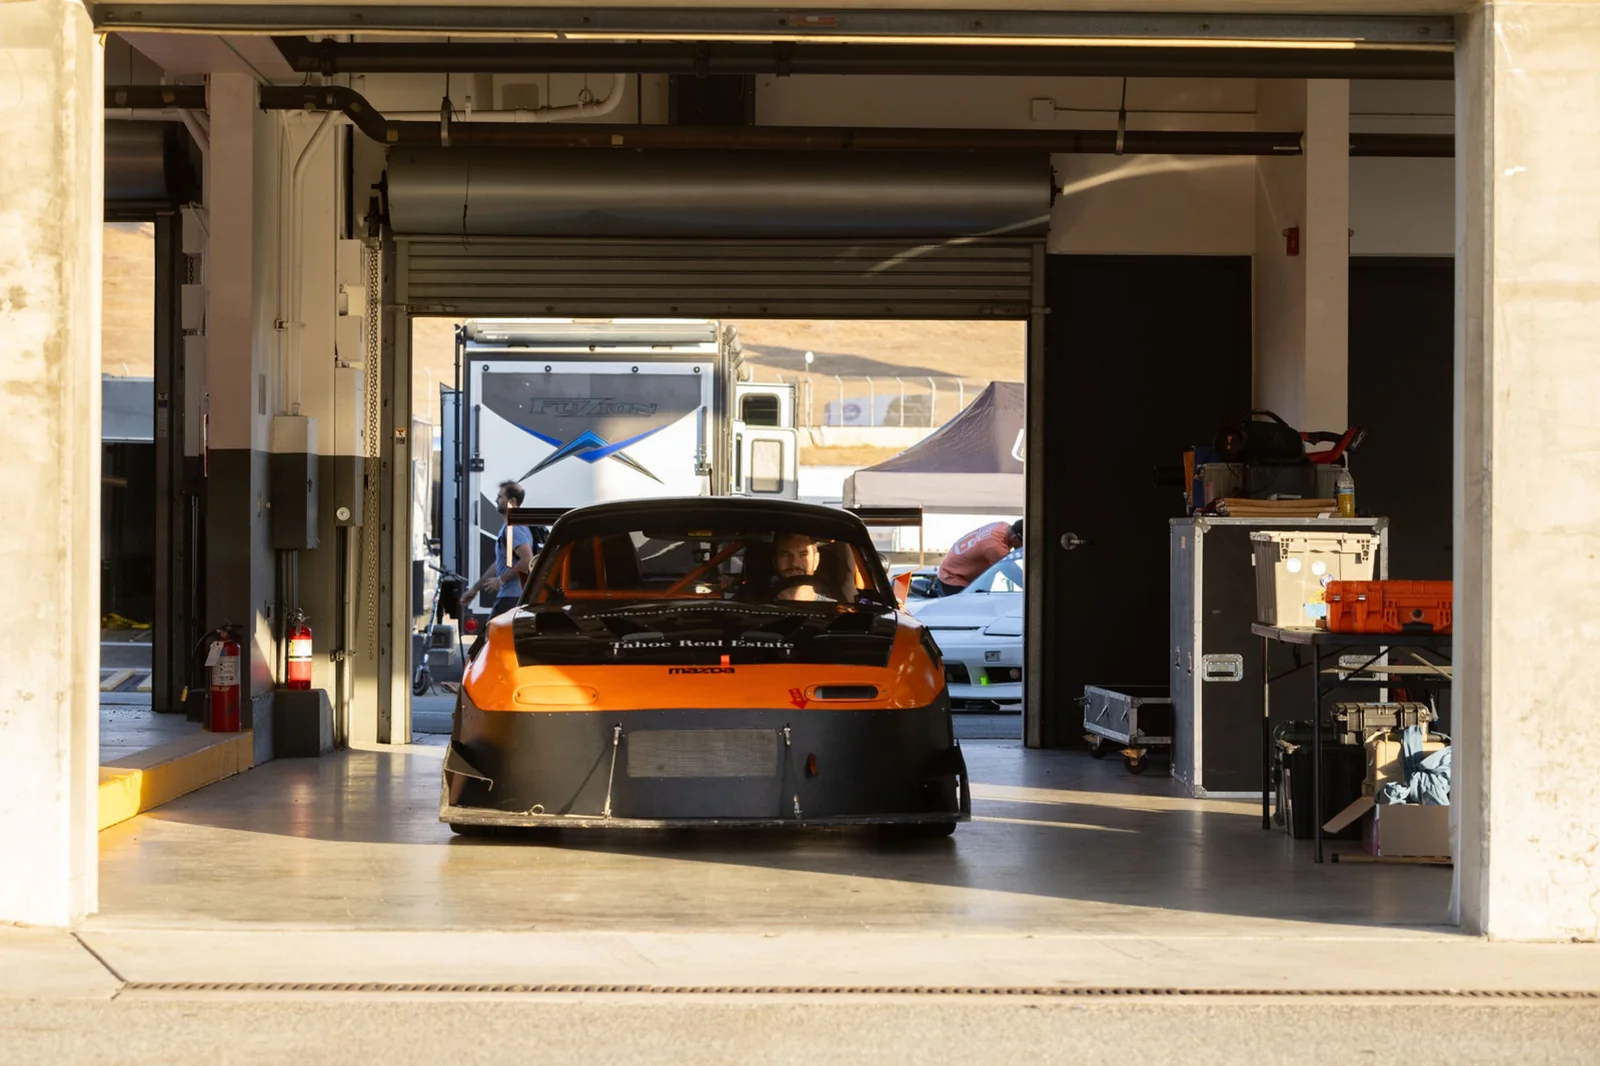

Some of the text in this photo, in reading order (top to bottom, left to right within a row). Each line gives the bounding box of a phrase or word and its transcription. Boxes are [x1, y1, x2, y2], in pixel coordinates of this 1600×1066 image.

[609, 639, 795, 649] Tahoe Real Estate
